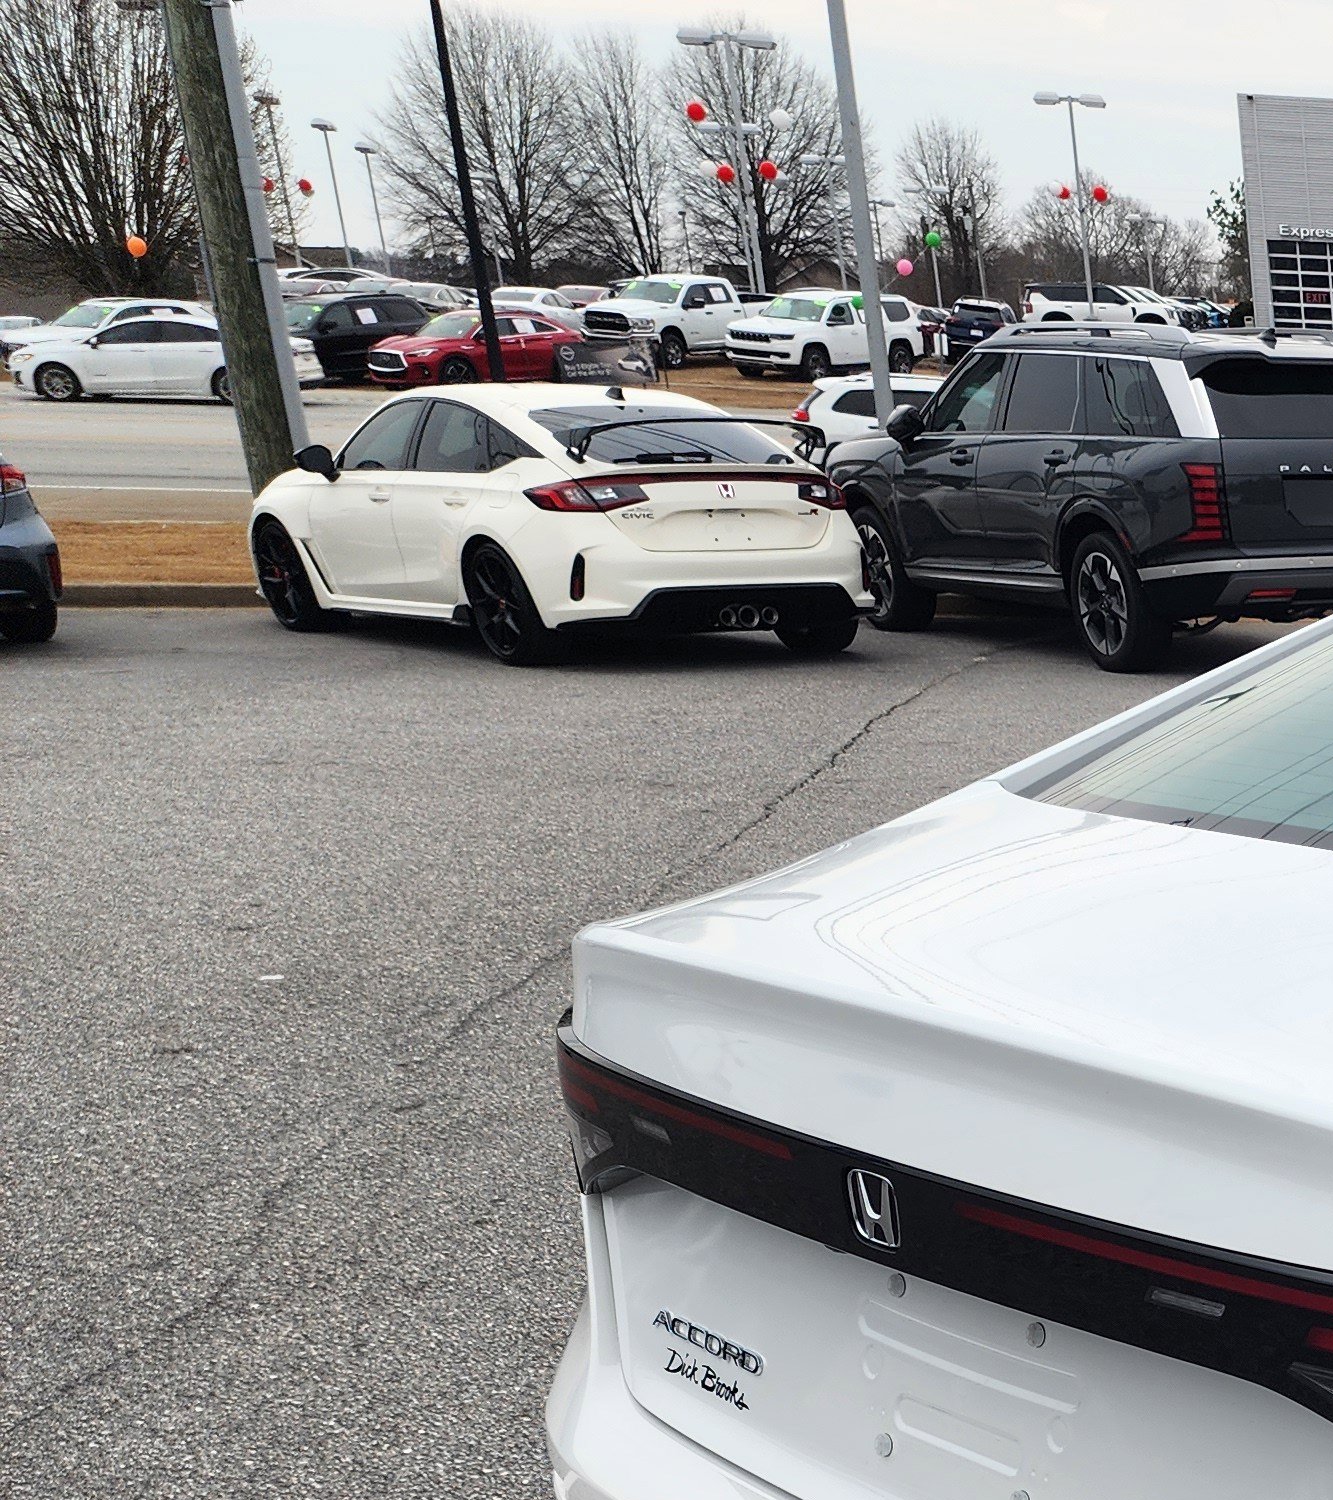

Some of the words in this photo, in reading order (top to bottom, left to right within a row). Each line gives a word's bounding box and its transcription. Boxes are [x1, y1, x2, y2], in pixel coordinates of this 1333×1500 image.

[1305, 293, 1328, 304] EXIT
[652, 1308, 766, 1376] ACCORD
[664, 1347, 698, 1385] Dick
[701, 1365, 750, 1411] Brooks
